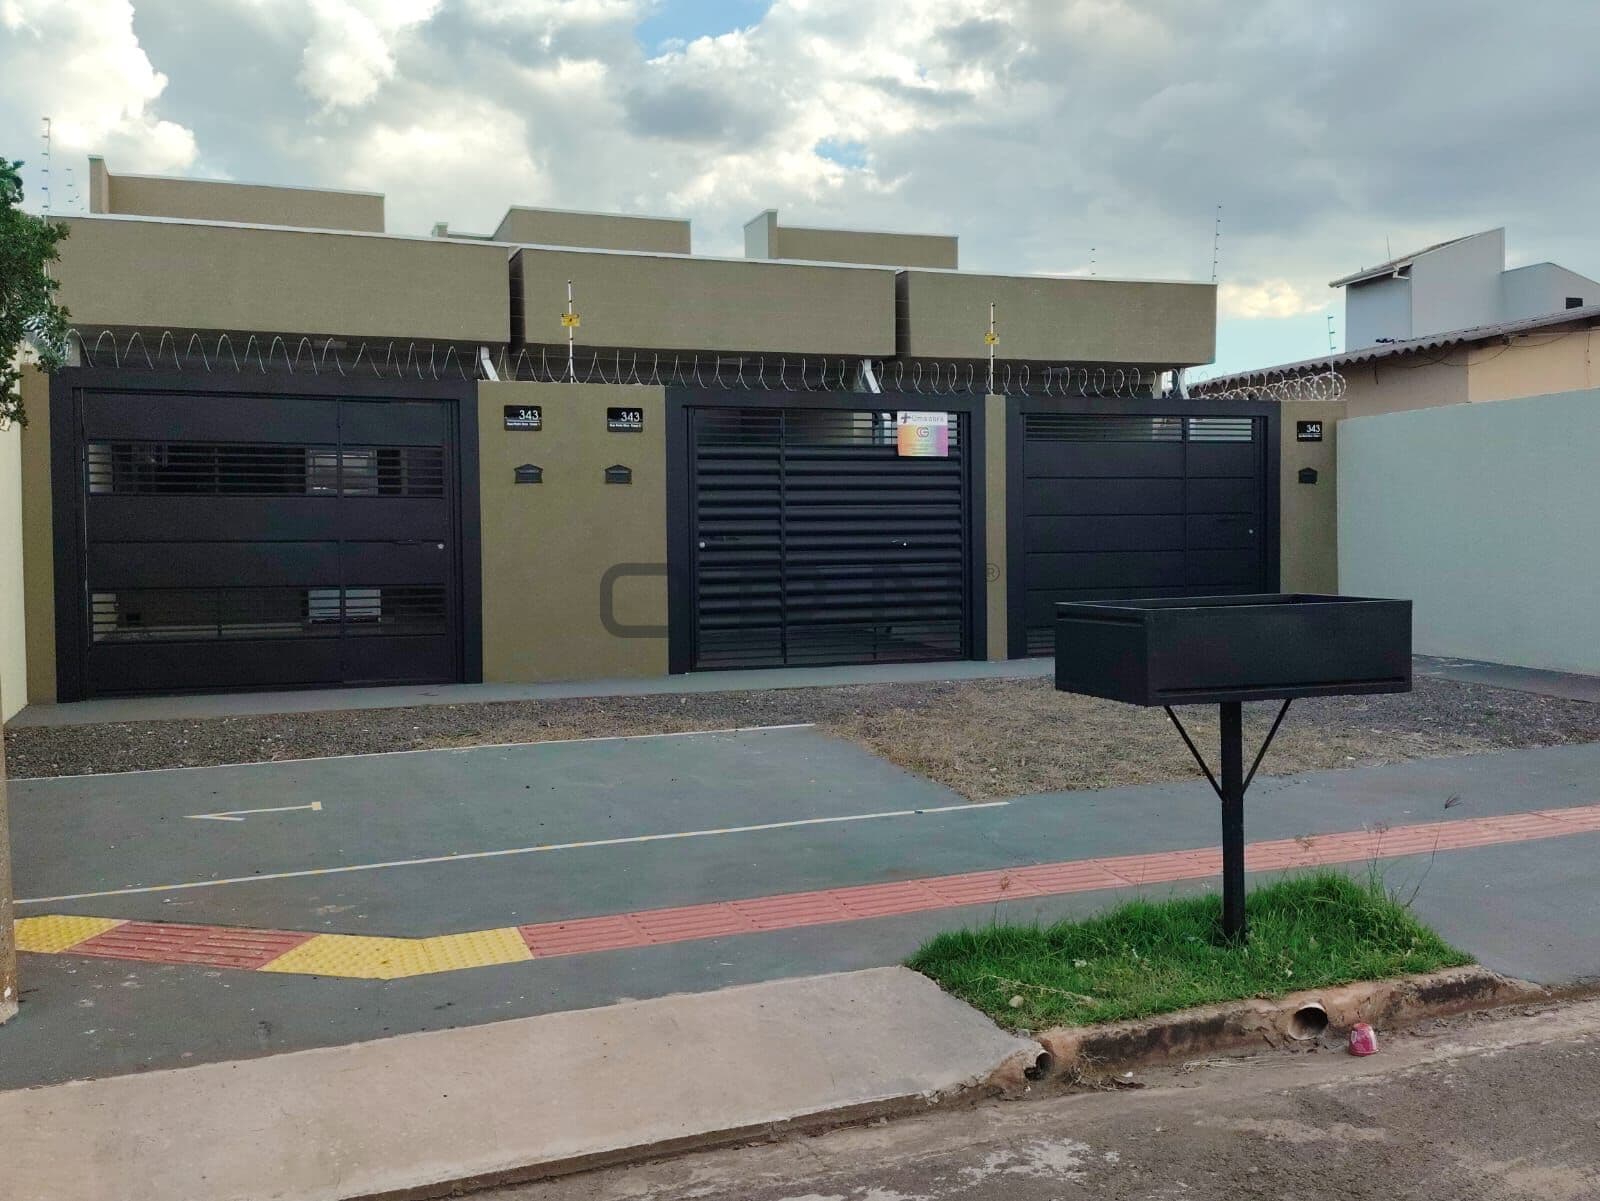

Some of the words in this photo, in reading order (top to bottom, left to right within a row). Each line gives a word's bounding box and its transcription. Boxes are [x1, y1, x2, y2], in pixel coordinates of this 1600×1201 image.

[519, 410, 539, 420] 343
[621, 411, 640, 422] 343
[1306, 424, 1320, 433] 343
